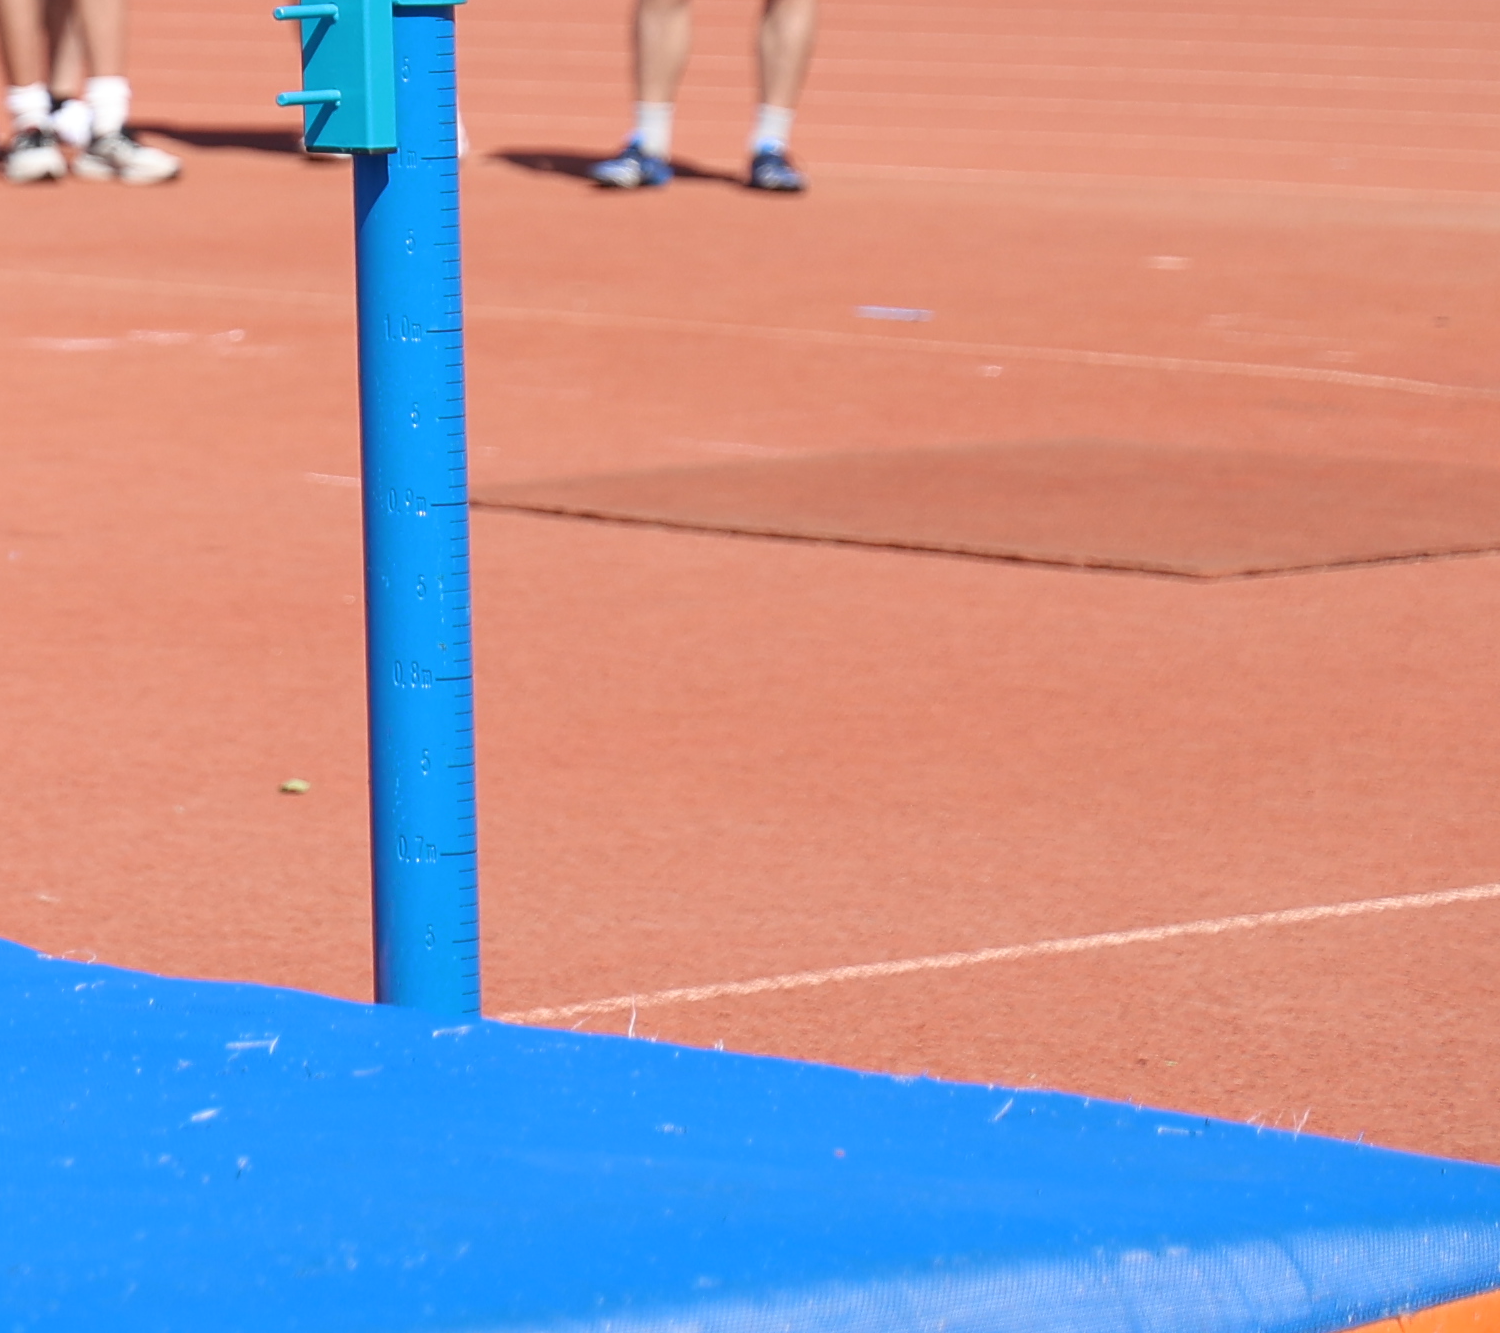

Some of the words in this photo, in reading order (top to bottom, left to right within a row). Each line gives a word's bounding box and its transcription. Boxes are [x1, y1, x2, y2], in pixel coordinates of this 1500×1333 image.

[383, 314, 422, 342] 1.0m
[388, 488, 426, 517] 0.9m
[392, 660, 432, 689] 0.8m
[397, 834, 437, 864] 0.7m
